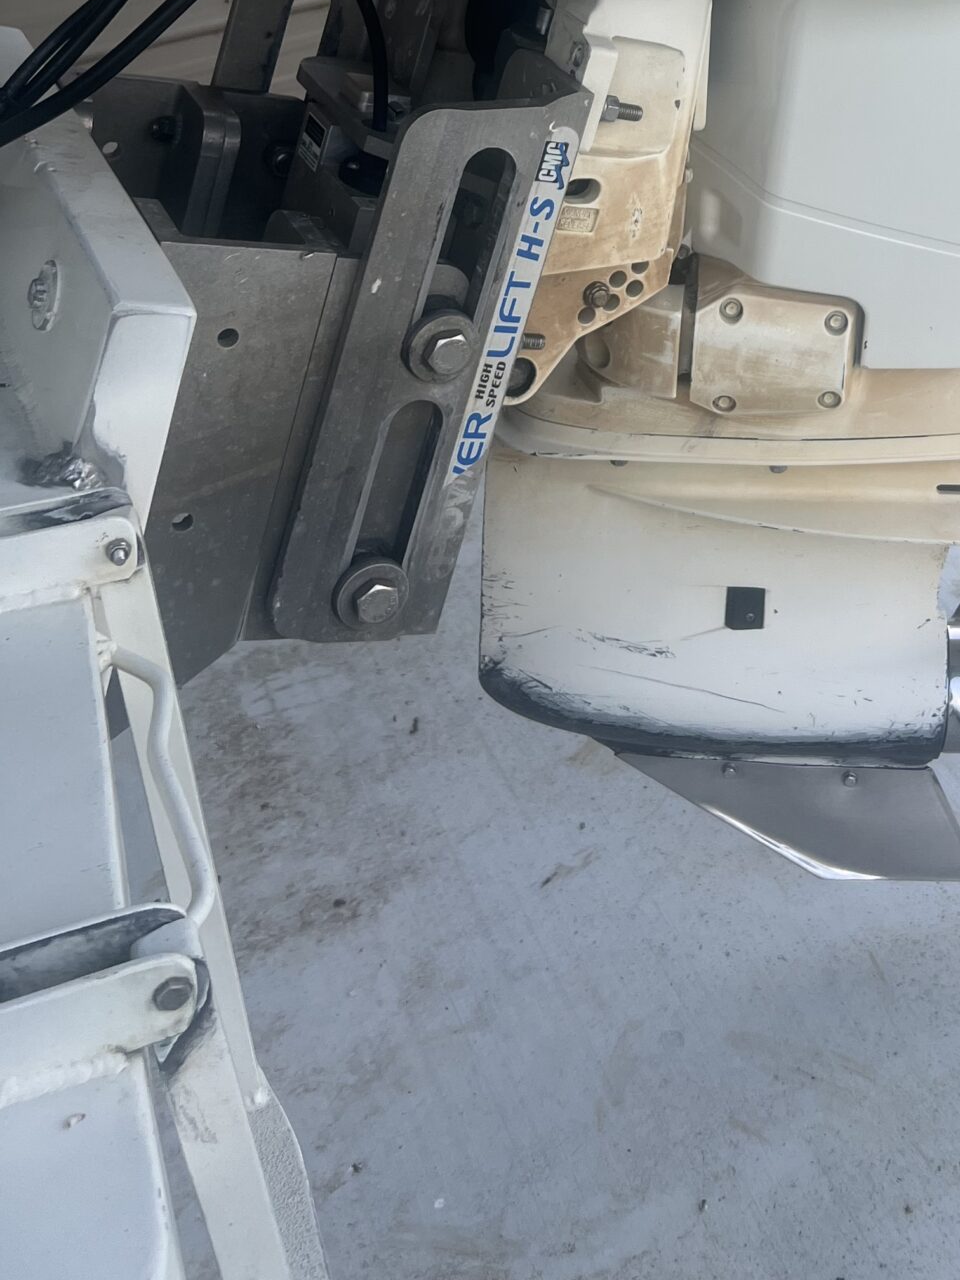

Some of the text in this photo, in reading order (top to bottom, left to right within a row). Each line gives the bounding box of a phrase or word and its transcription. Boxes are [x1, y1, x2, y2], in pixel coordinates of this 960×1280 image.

[538, 141, 568, 183] CMC
[486, 270, 532, 359] LIFT
[516, 195, 556, 262] H-S
[474, 363, 493, 400] HIGH
[485, 361, 507, 408] SPEED
